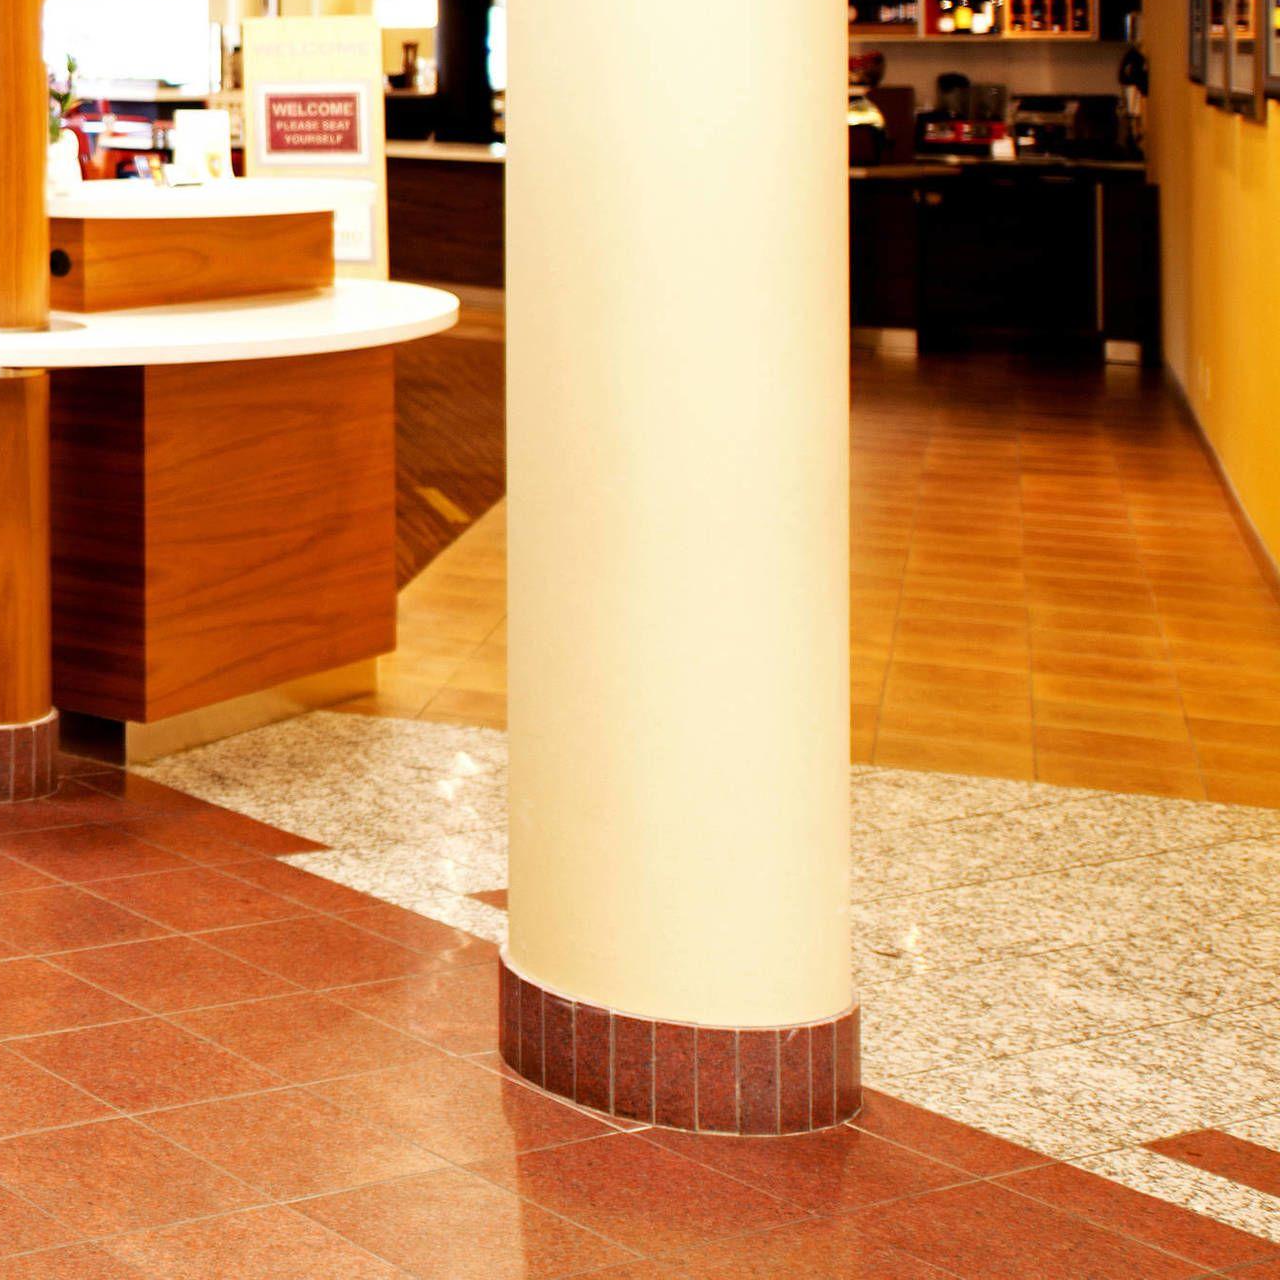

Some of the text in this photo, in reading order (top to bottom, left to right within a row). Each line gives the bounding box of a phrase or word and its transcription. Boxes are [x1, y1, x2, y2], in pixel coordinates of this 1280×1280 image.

[272, 101, 354, 117] WELCOME
[275, 120, 351, 131] PLEASE SEAT
[284, 134, 344, 146] YOURSELF
